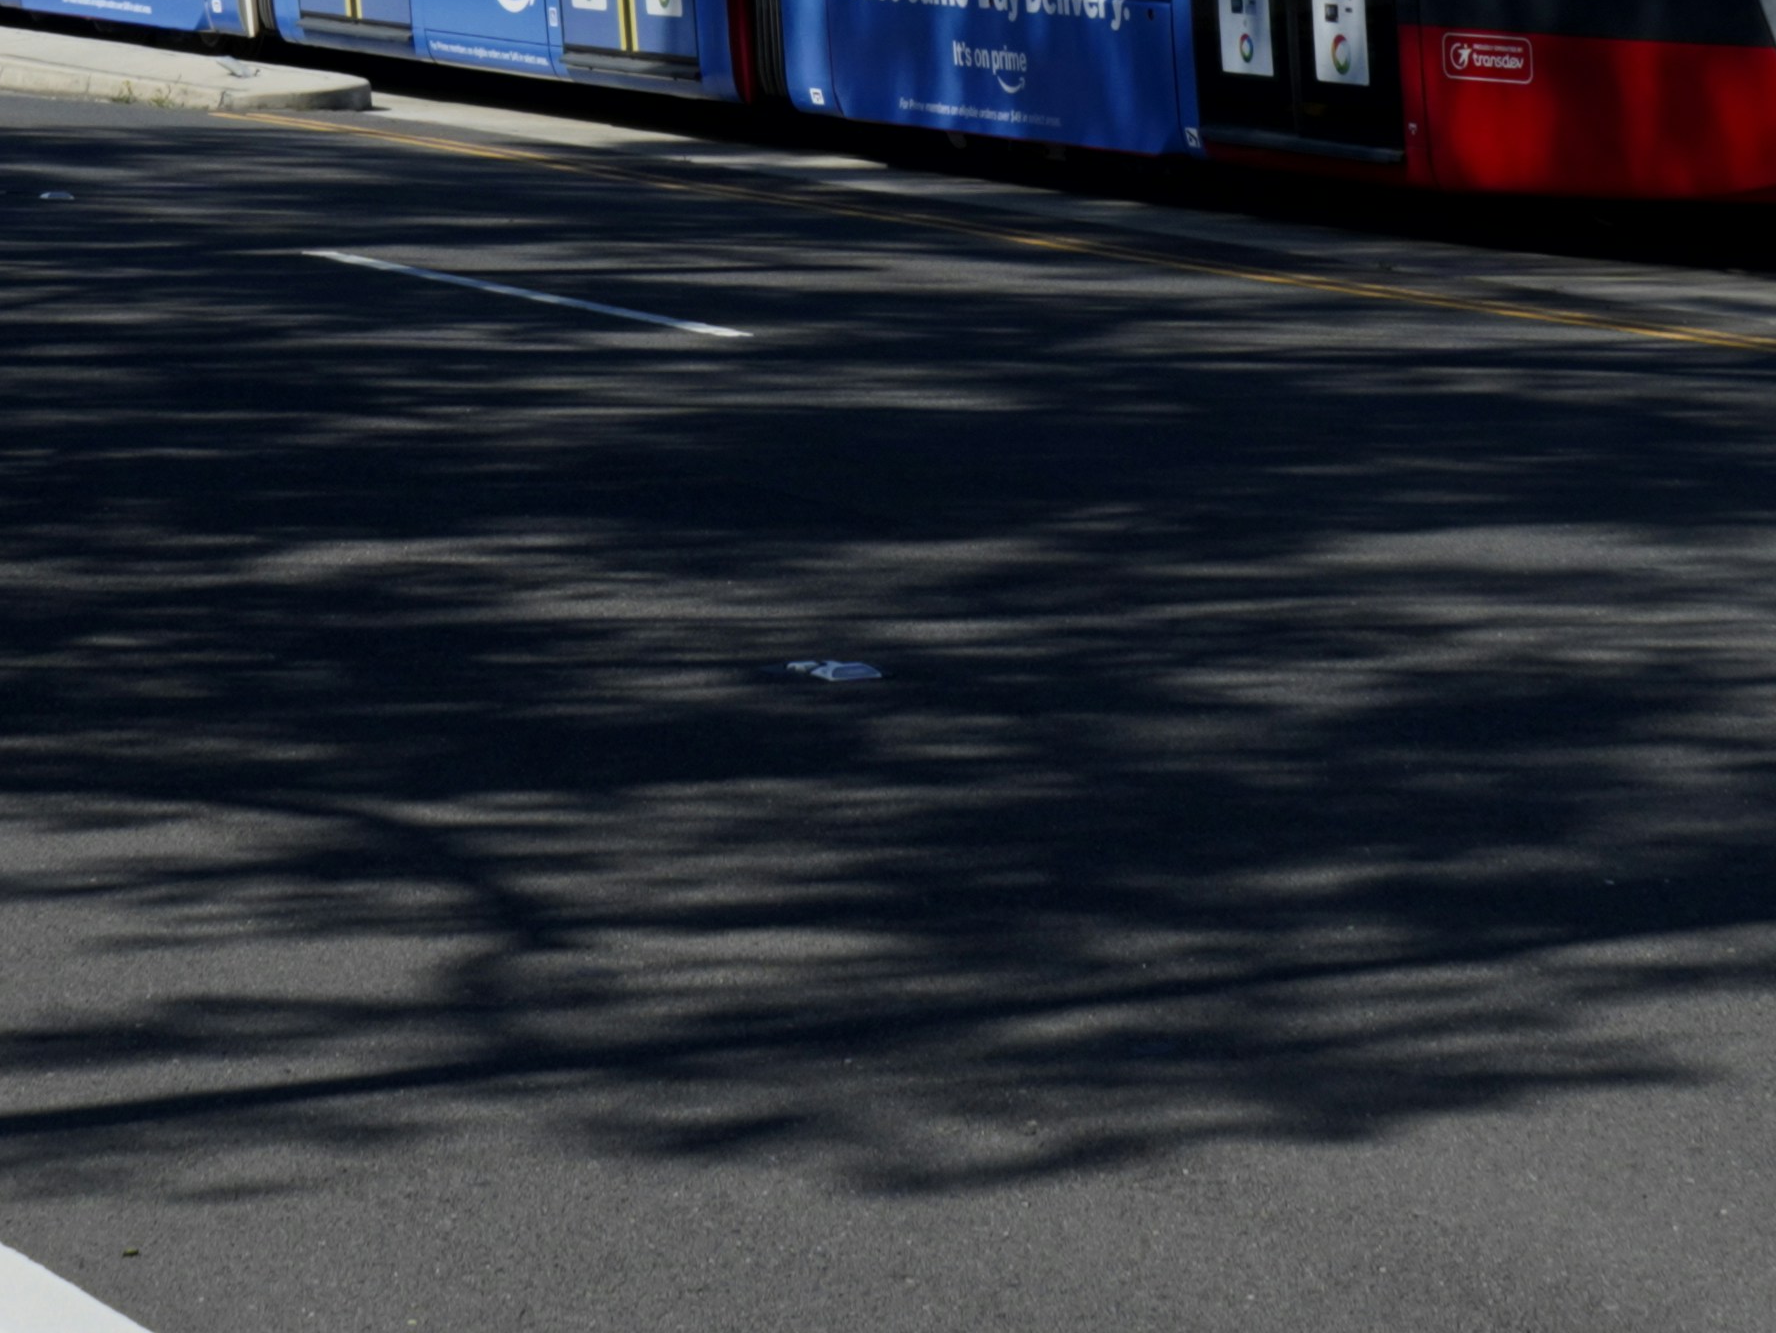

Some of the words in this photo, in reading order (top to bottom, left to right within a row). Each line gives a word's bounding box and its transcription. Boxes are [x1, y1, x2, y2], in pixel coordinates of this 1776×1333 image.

[952, 40, 972, 67] It's
[974, 46, 990, 69] on
[991, 45, 1028, 76] prime
[1472, 52, 1524, 69] transdev
